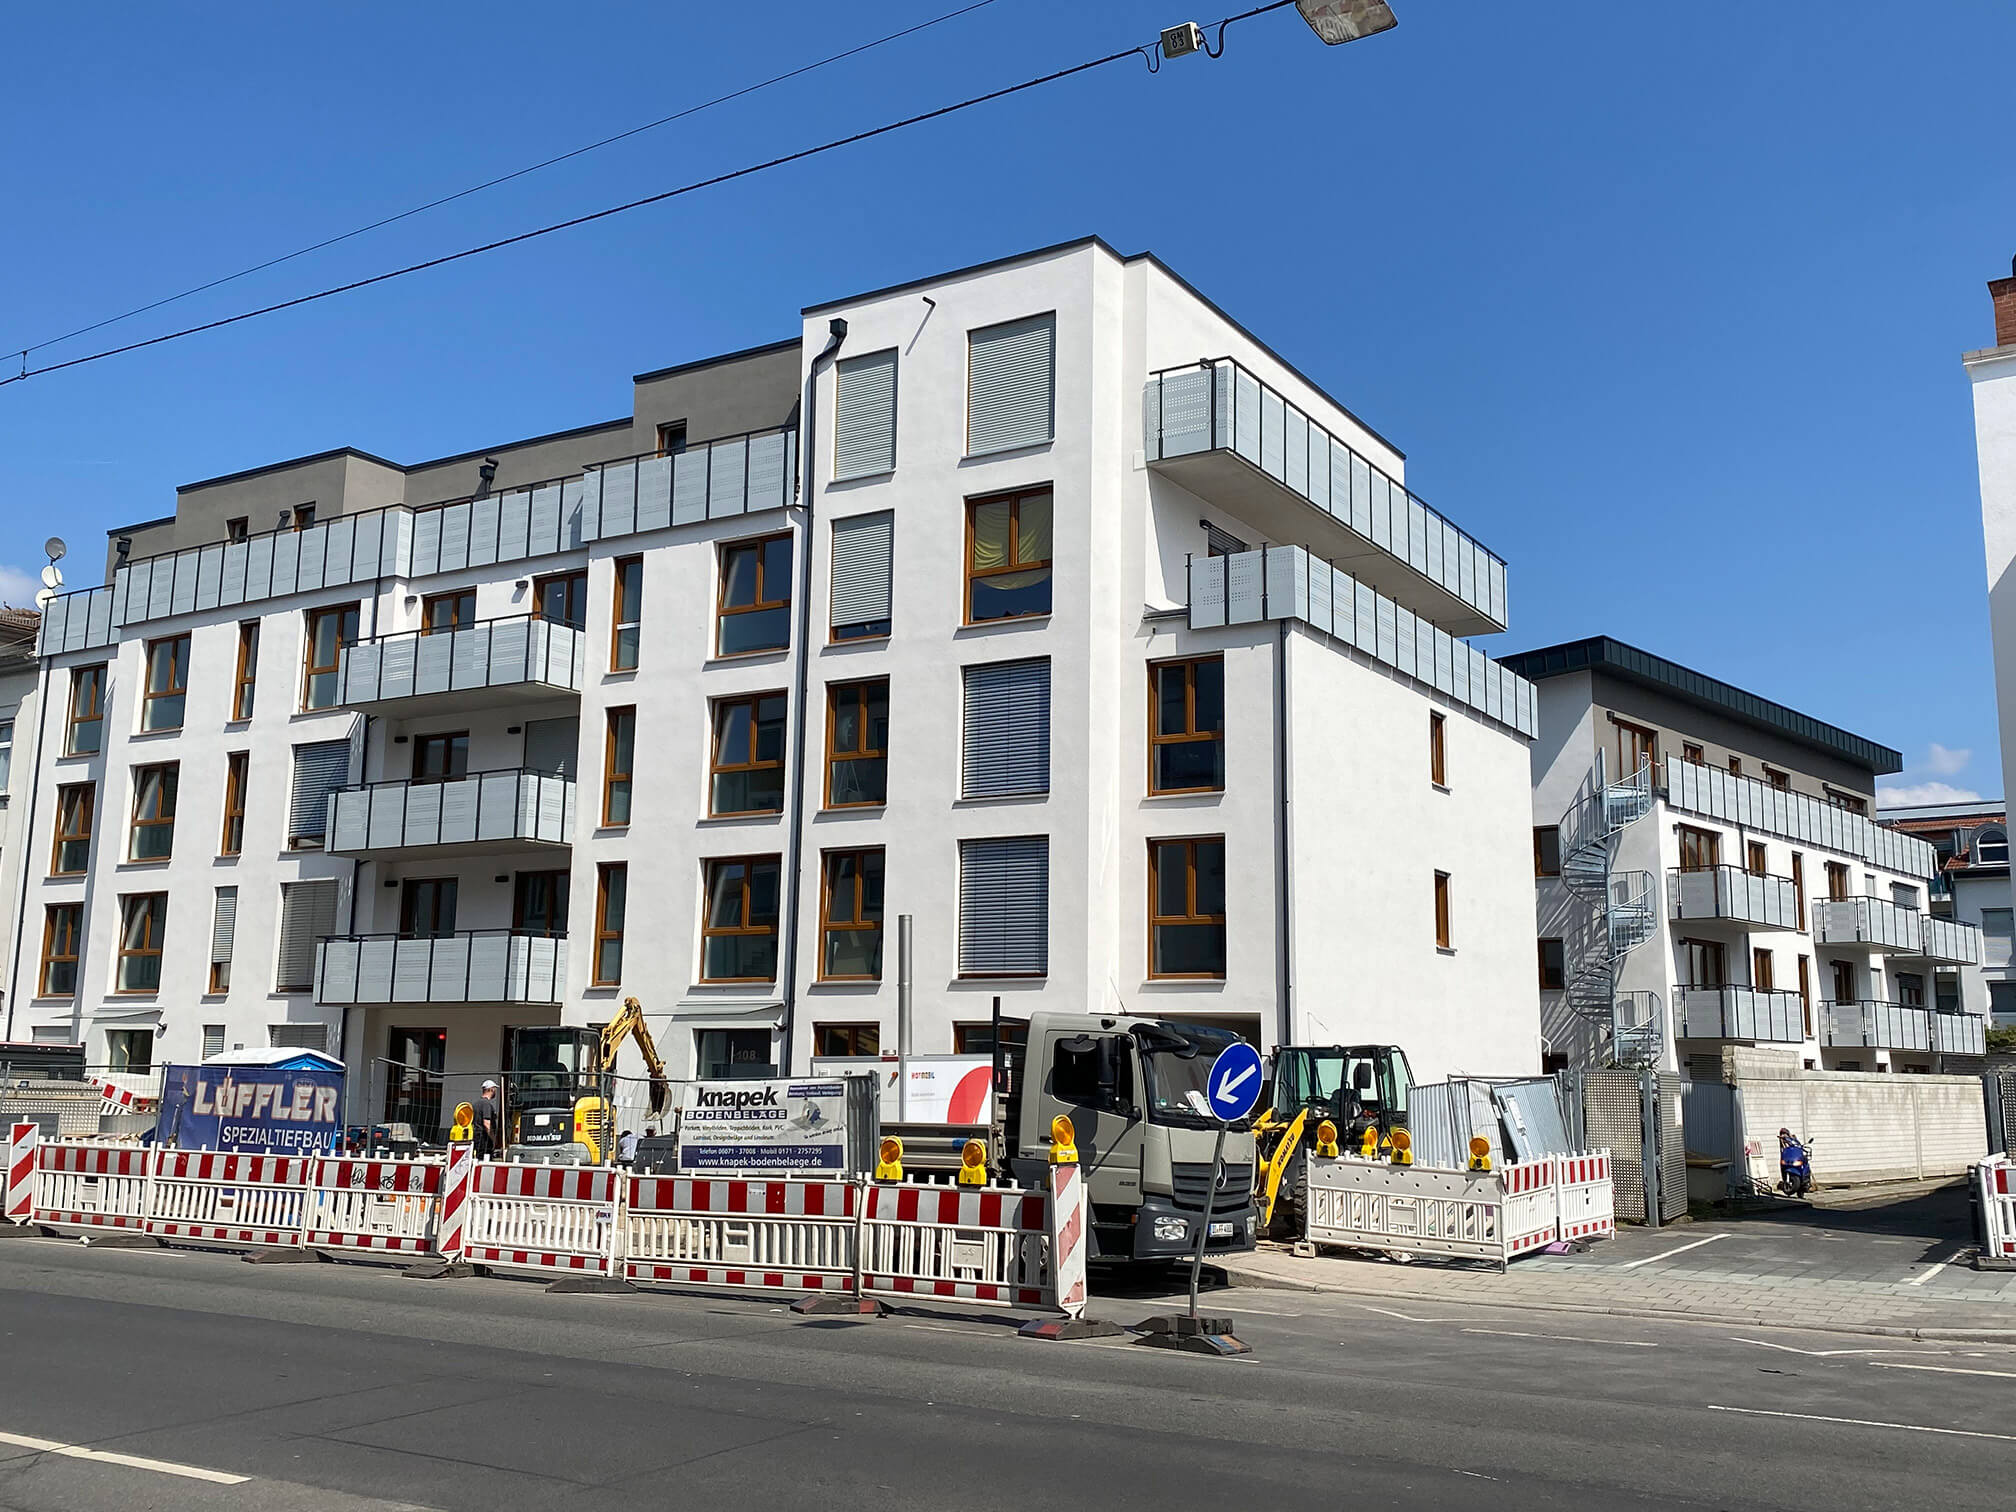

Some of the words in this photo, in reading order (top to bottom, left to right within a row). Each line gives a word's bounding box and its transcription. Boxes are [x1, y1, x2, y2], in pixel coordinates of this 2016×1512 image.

[1172, 39, 1185, 48] 03
[696, 1086, 779, 1111] knapek
[222, 1125, 333, 1150] SPEZIALTIEFBAU
[526, 1133, 562, 1142] KOMATSU
[698, 1156, 823, 1168] www.knapek-bodenbelaege.de
